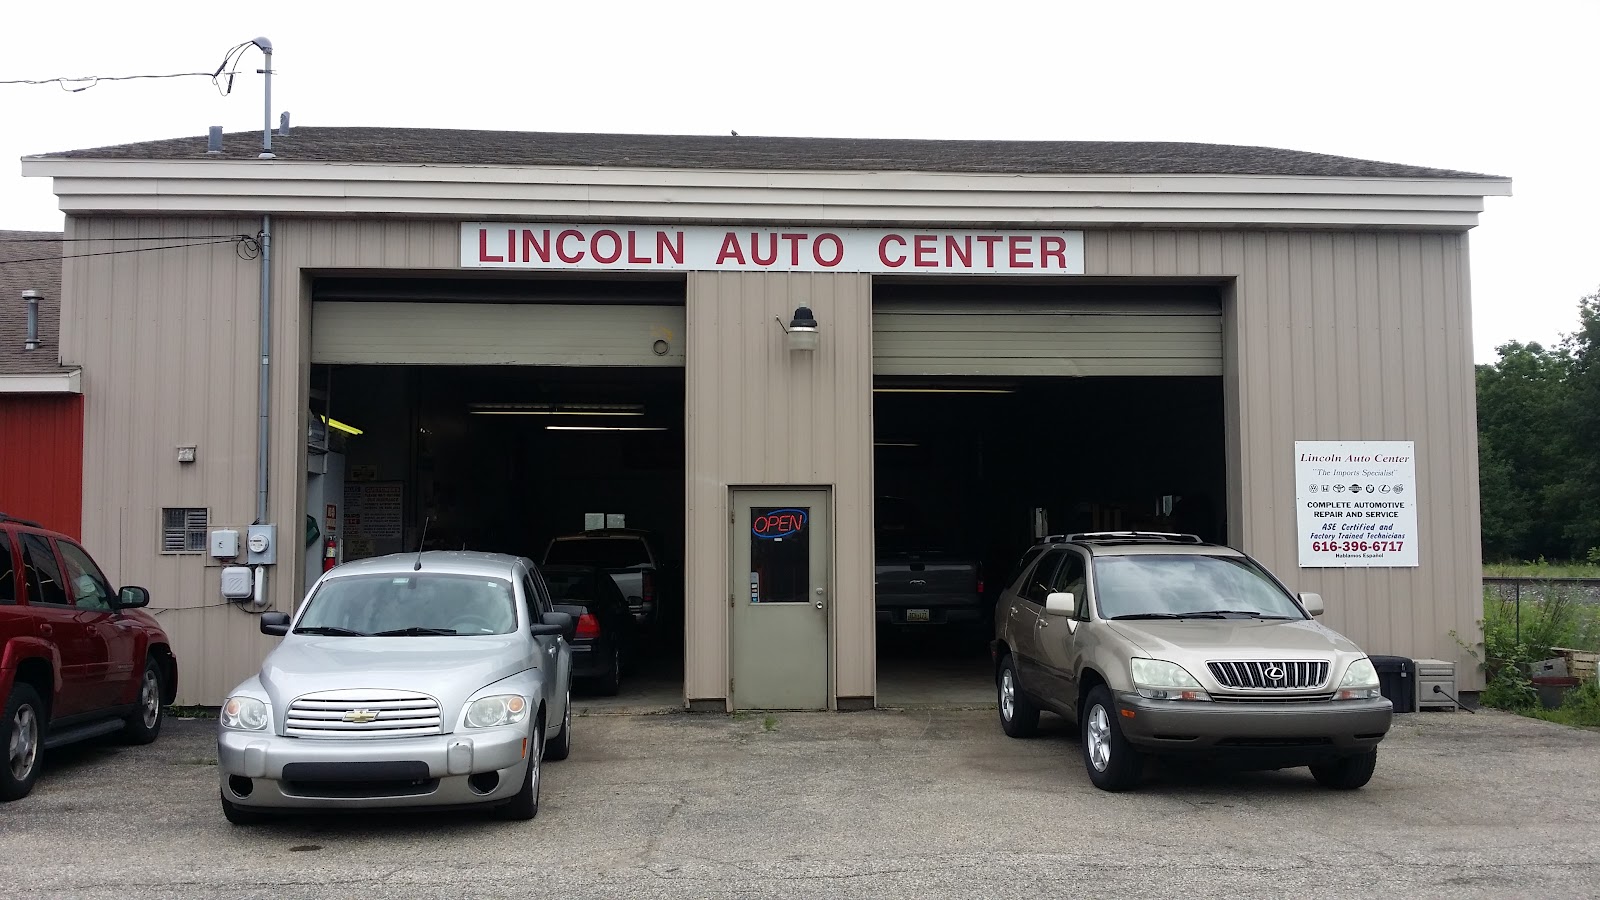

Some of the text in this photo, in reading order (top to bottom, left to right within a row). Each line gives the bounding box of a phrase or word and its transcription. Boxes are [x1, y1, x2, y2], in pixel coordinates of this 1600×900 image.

[478, 228, 1068, 269] LINCOLN AUTO CENTER
[1300, 453, 1410, 463] Lincoln Auto Center
[1333, 469, 1360, 477] Imports
[1307, 501, 1405, 509] COMPLETE AUTOMOTIVE
[753, 514, 803, 533] OPEN
[1322, 523, 1394, 531] ASE Certified and
[1310, 532, 1406, 541] Factory Trained Technicians
[1312, 541, 1404, 552] 616-396-6717
